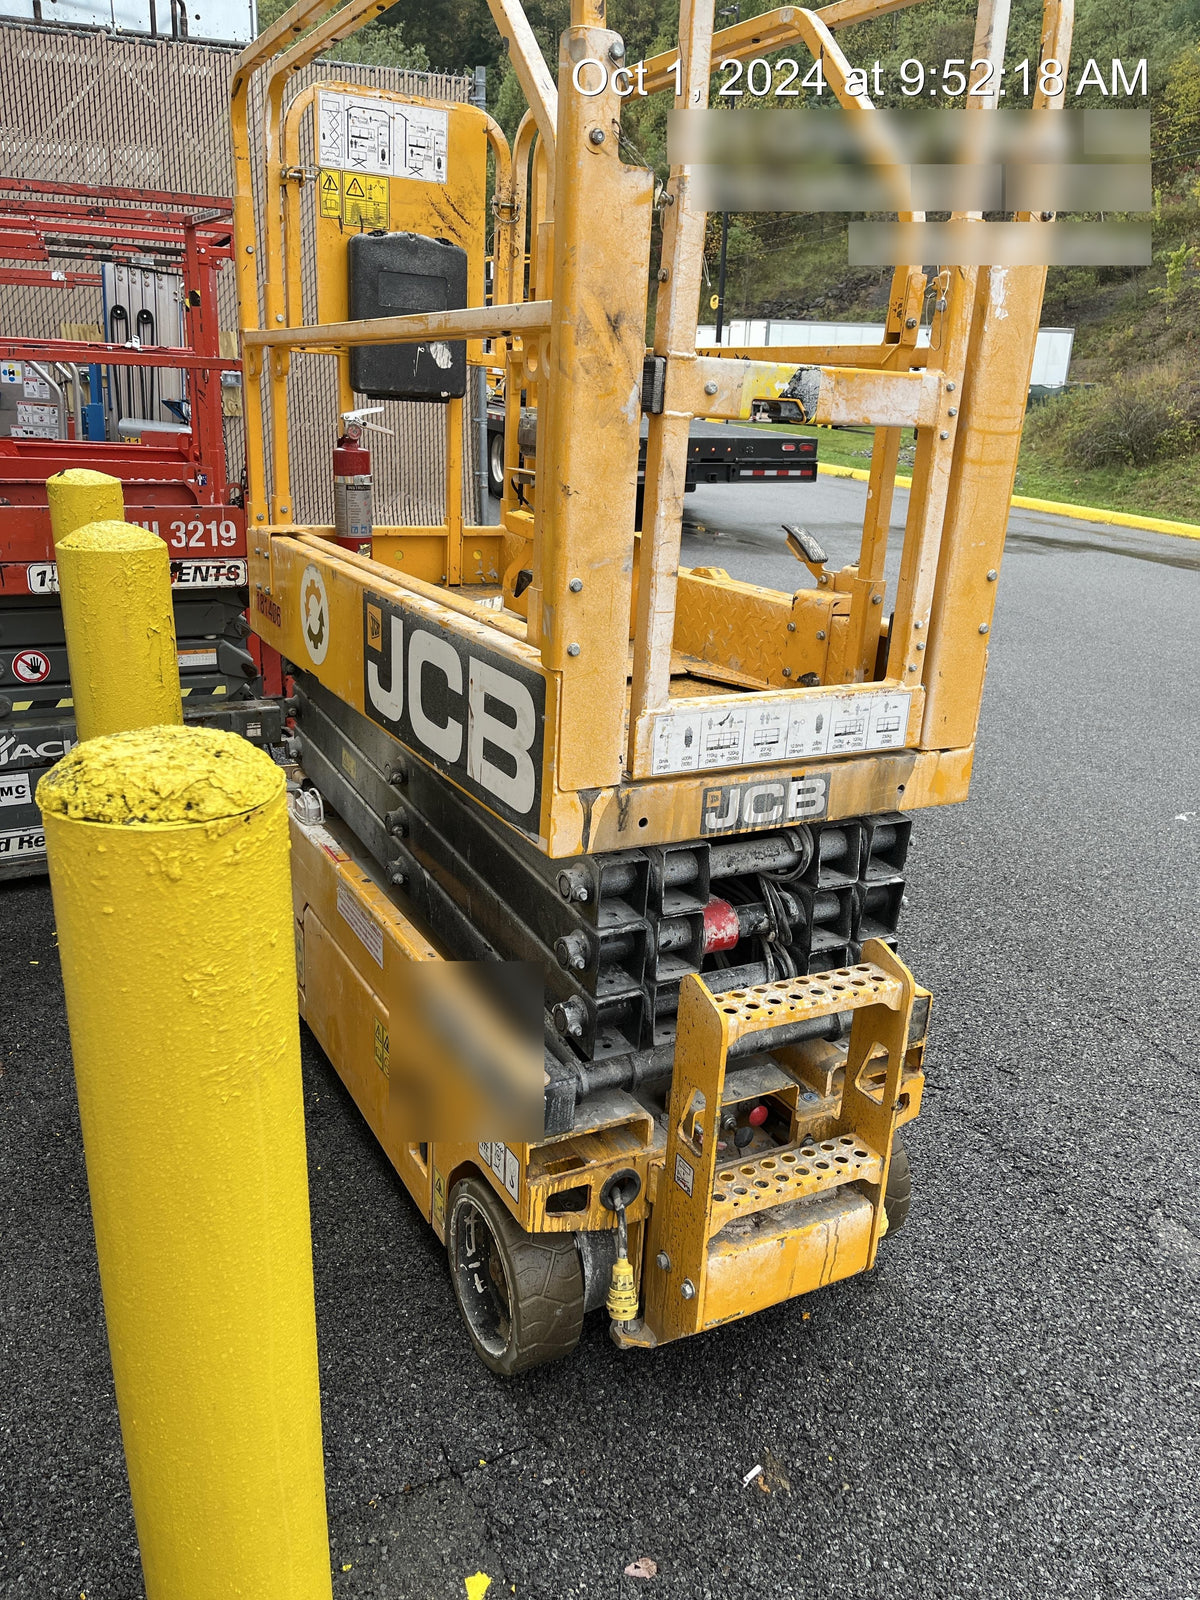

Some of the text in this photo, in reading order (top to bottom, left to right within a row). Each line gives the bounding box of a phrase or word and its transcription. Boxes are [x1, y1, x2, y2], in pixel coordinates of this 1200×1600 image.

[170, 520, 237, 548] 3219
[368, 615, 536, 814] JCB
[705, 779, 826, 829] JCB
